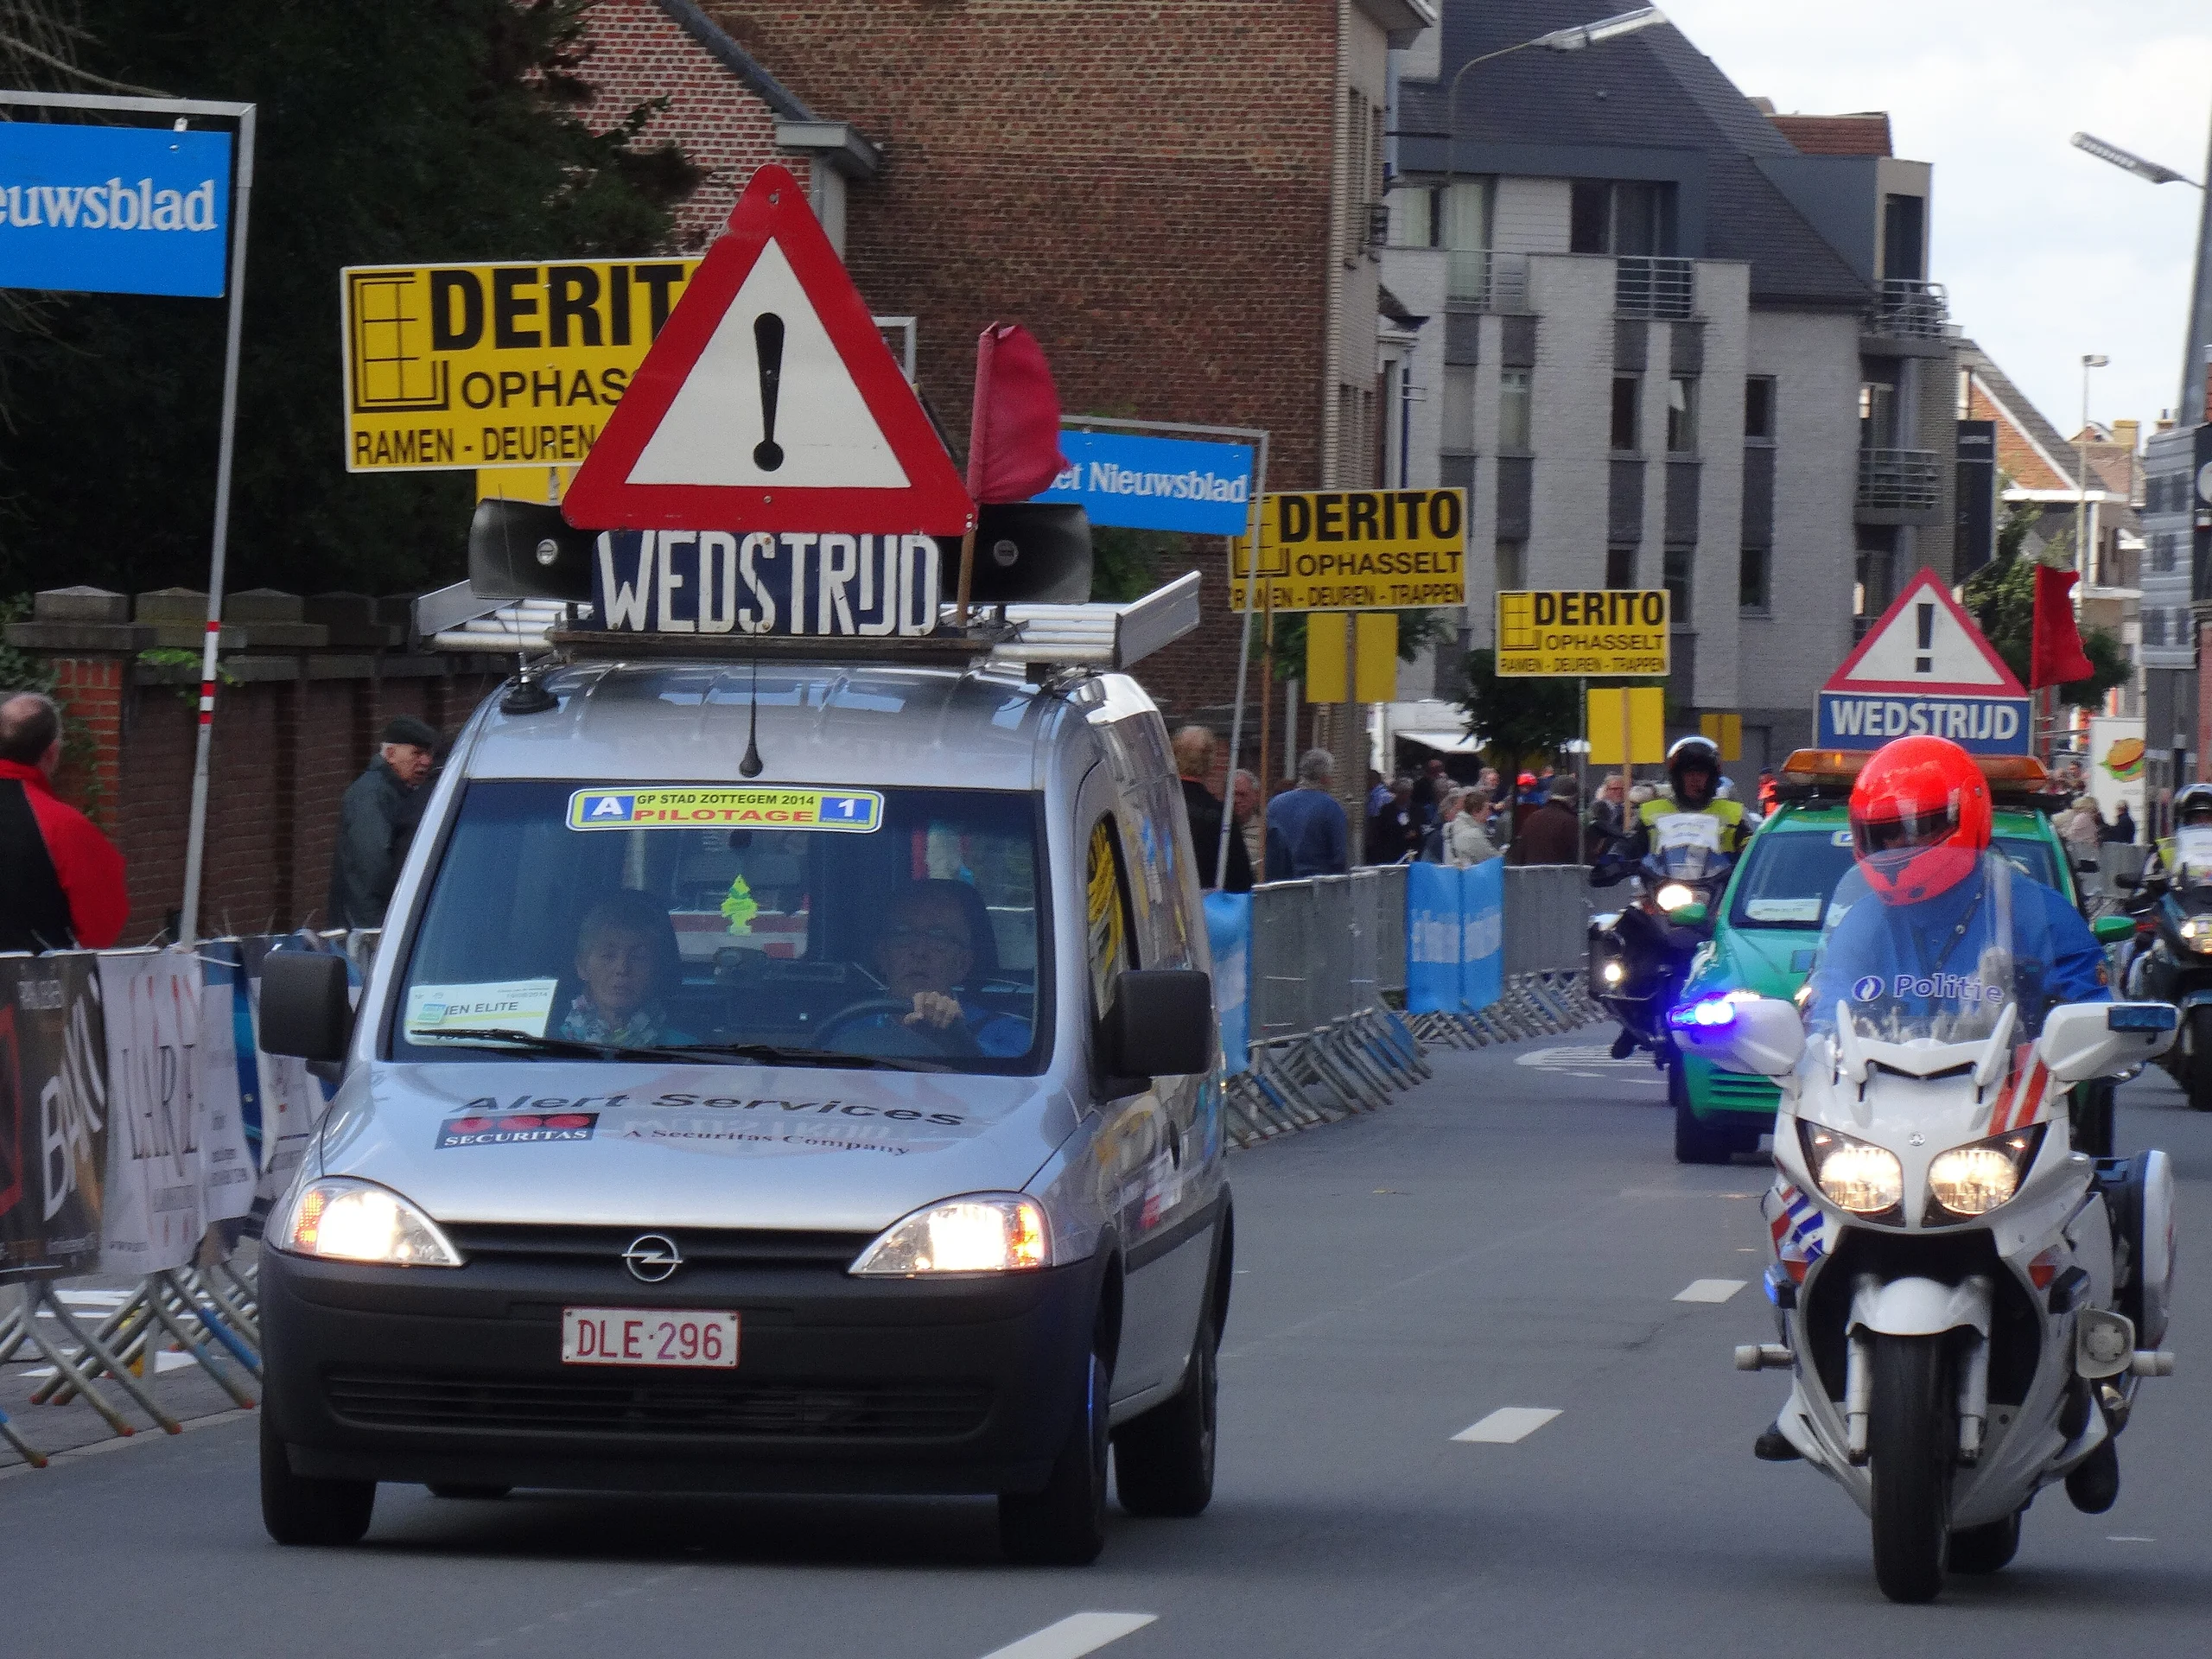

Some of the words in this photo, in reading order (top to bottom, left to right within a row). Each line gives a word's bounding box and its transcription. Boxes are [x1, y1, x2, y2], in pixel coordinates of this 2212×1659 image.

[429, 264, 696, 352] DERIT
[461, 367, 637, 410] OPHAS
[356, 429, 454, 465] RAMEN
[484, 424, 596, 461] DEUREN
[1050, 462, 1083, 491] et
[1089, 461, 1249, 504] Nieuwsblad
[1280, 490, 1461, 543] DERITO
[1297, 550, 1463, 577] OPHASSELT
[597, 530, 939, 637] WEDSTRIJD
[1389, 582, 1465, 605] TRAPPEN
[1534, 591, 1664, 626] DERITO
[1546, 634, 1664, 651] OPHASSELT
[1830, 700, 2020, 741] WEDSTRIJD
[591, 797, 625, 816] A
[637, 794, 656, 804] GP
[660, 793, 696, 804] STAD
[700, 793, 778, 804] ZOTTEGEM
[781, 795, 815, 805] 2014
[837, 798, 855, 817] 1
[633, 809, 814, 822] PILOTAGE
[1892, 972, 2005, 1004] Politie
[474, 1001, 519, 1014] ELITE
[448, 1094, 630, 1113] Alert
[652, 1093, 966, 1126] Services
[444, 1129, 588, 1147] SECURITAS
[623, 1129, 642, 1139] A
[652, 1128, 772, 1142] Securitas
[782, 1134, 910, 1156] Company
